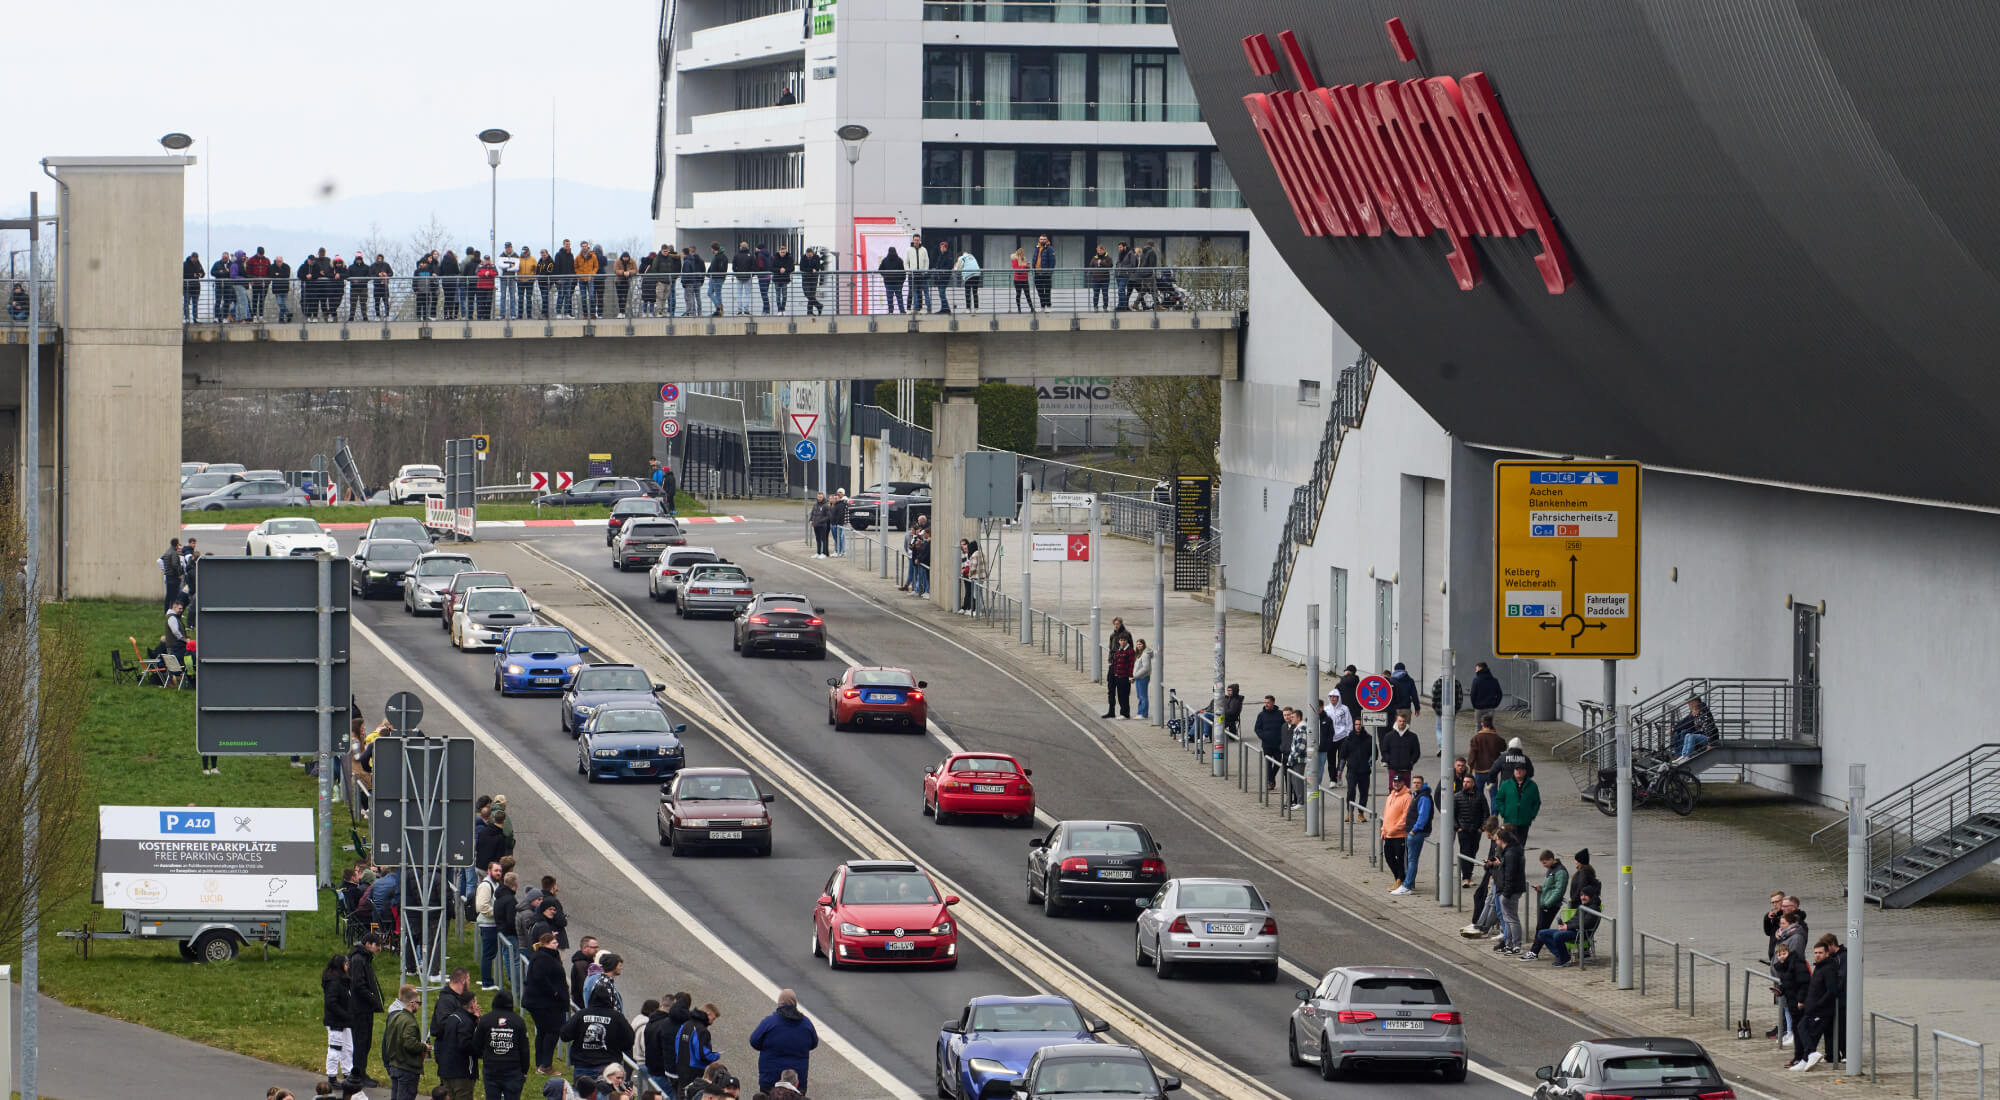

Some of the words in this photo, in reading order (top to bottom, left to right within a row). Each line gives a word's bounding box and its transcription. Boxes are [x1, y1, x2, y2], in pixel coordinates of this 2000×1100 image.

[1037, 386, 1110, 400] ASINO
[664, 423, 676, 433] 50
[477, 439, 483, 449] 5
[1529, 487, 1563, 496] Aachen
[1529, 499, 1588, 508] Blankenheim
[1532, 512, 1616, 522] Fahrsicherheits-Z.
[1534, 525, 1543, 535] C
[1559, 525, 1567, 535] D
[1504, 568, 1540, 578] Kelberg
[1505, 579, 1557, 588] Welcherath
[1587, 595, 1626, 606] Fahrerlager
[1510, 605, 1518, 615] B
[1524, 605, 1533, 615] C
[1587, 606, 1625, 616] Paddock
[166, 814, 179, 831] P
[184, 818, 211, 828] A10
[138, 841, 209, 852] KOSTENFREIE
[211, 842, 277, 853] PARKPLÄTZE
[155, 852, 178, 861] FREE
[180, 852, 224, 862] PARKING
[226, 853, 262, 862] SPACES
